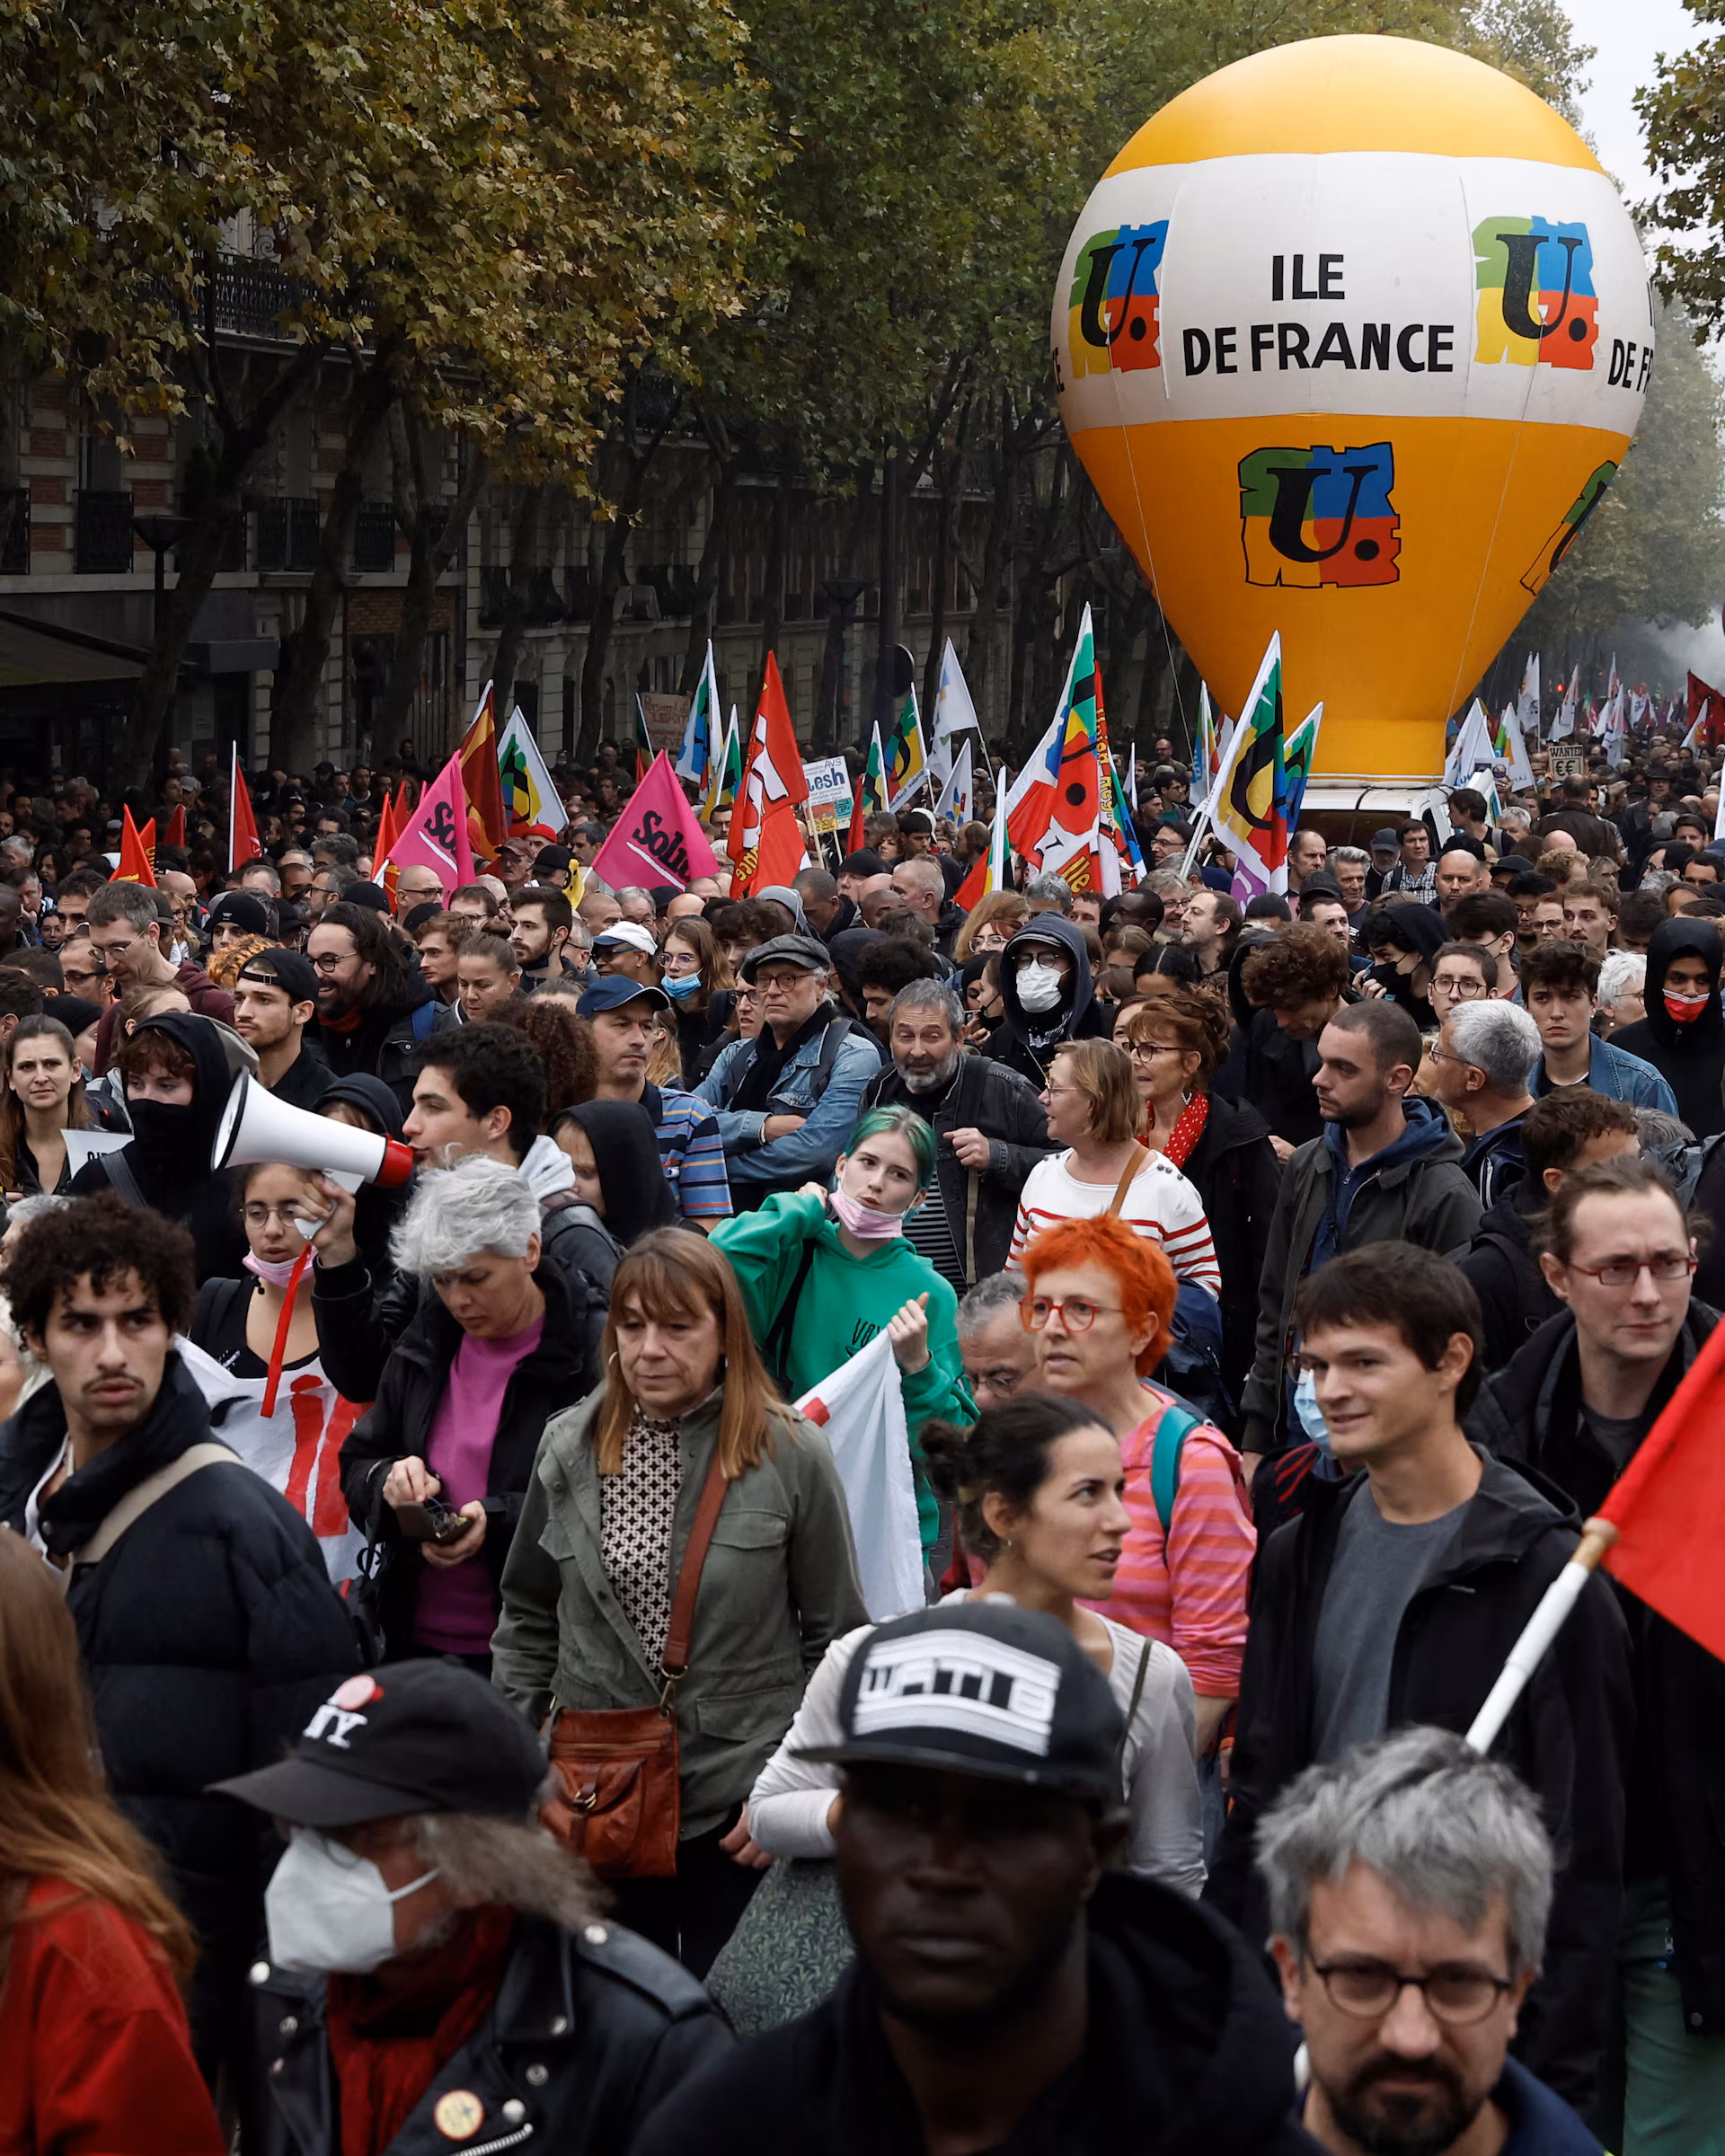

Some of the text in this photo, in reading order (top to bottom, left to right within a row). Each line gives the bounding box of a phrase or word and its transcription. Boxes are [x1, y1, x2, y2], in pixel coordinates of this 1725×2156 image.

[1272, 253, 1345, 301] ILE
[1182, 323, 1455, 376] DE FRANCE
[1607, 339, 1637, 388] DE
[824, 757, 842, 770] AVS
[1549, 747, 1583, 757] WANTED
[424, 800, 456, 856] So
[302, 1703, 368, 1749] NY
